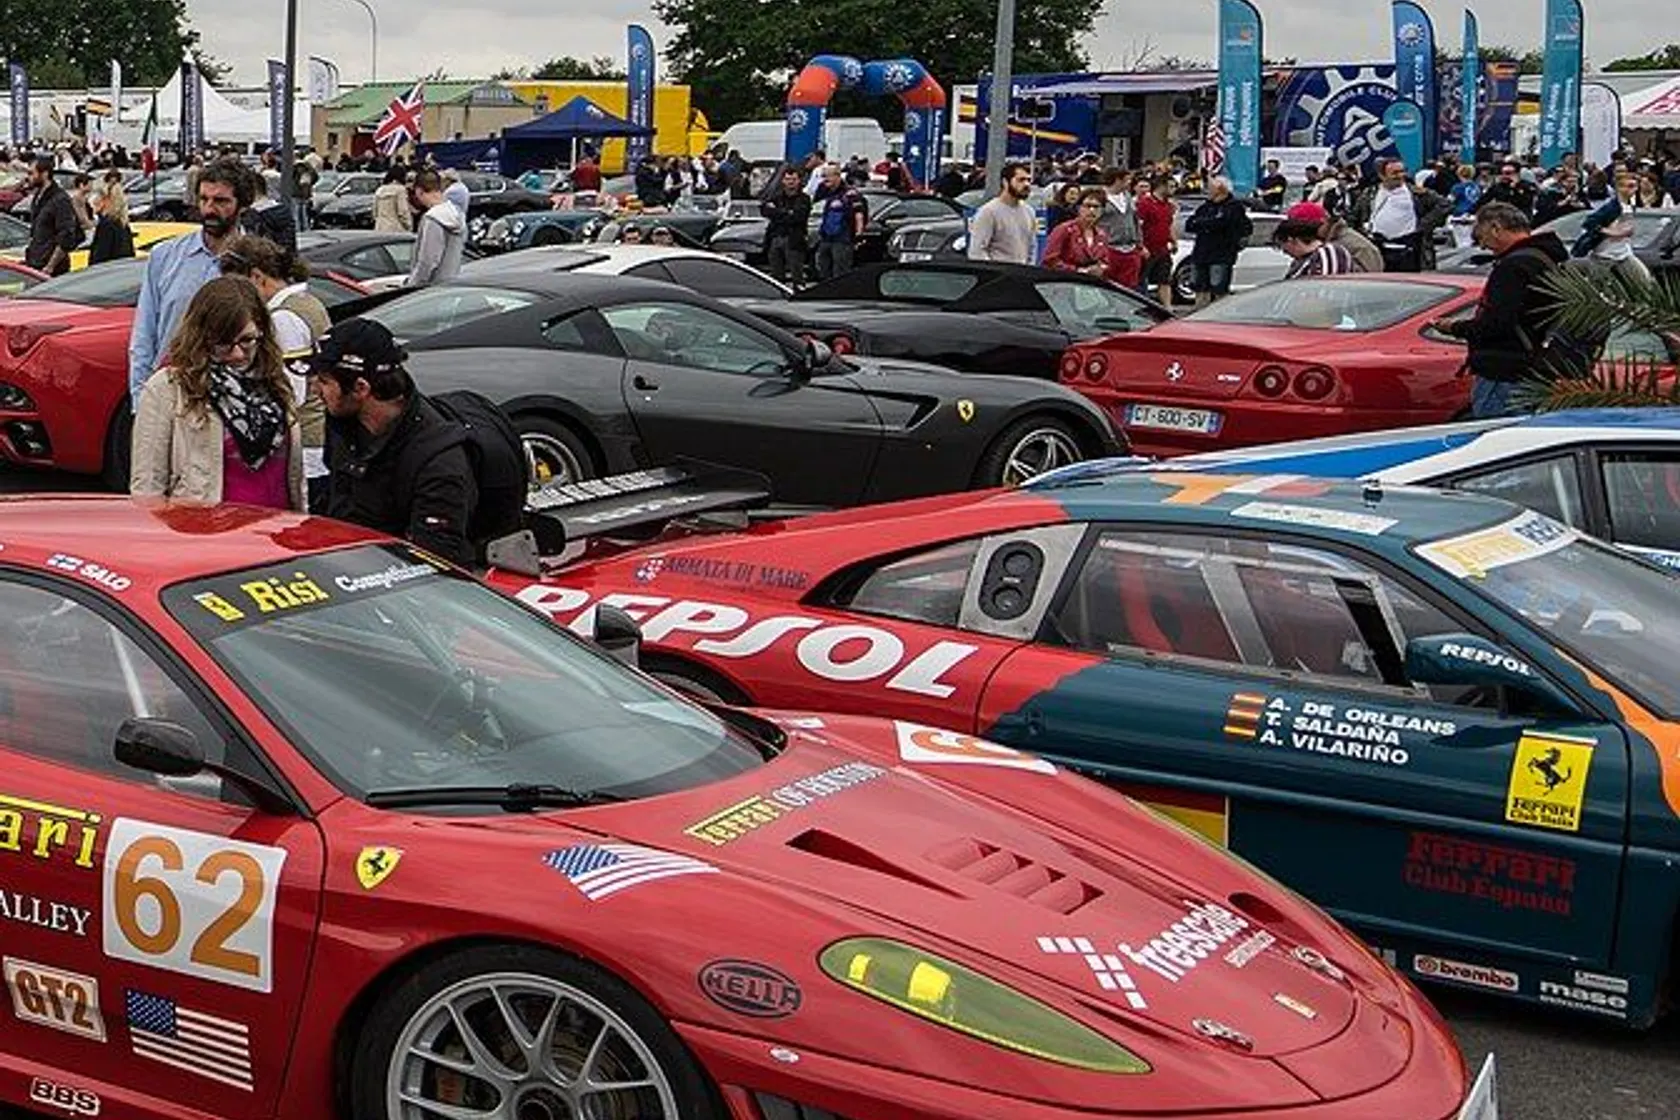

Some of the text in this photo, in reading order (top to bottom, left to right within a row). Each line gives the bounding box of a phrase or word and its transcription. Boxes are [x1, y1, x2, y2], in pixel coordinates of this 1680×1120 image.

[79, 563, 132, 592] SALO
[664, 556, 729, 579] ARMATA
[240, 572, 330, 613] Risi
[1439, 642, 1532, 677] REPSOL
[1267, 696, 1457, 737] A. DE ORLEANS
[1292, 716, 1402, 746] SALDAÑA
[1259, 731, 1410, 765] A. VILARIÑO
[1512, 797, 1576, 818] Ferrari
[1402, 860, 1466, 894] Club
[1409, 832, 1576, 893] Ferrari
[114, 835, 266, 978] 62
[1116, 899, 1249, 983] freescale
[705, 969, 802, 1011] HELLA
[1439, 961, 1516, 989] brembo
[14, 969, 95, 1031] GT2
[33, 1081, 98, 1113] BBS
